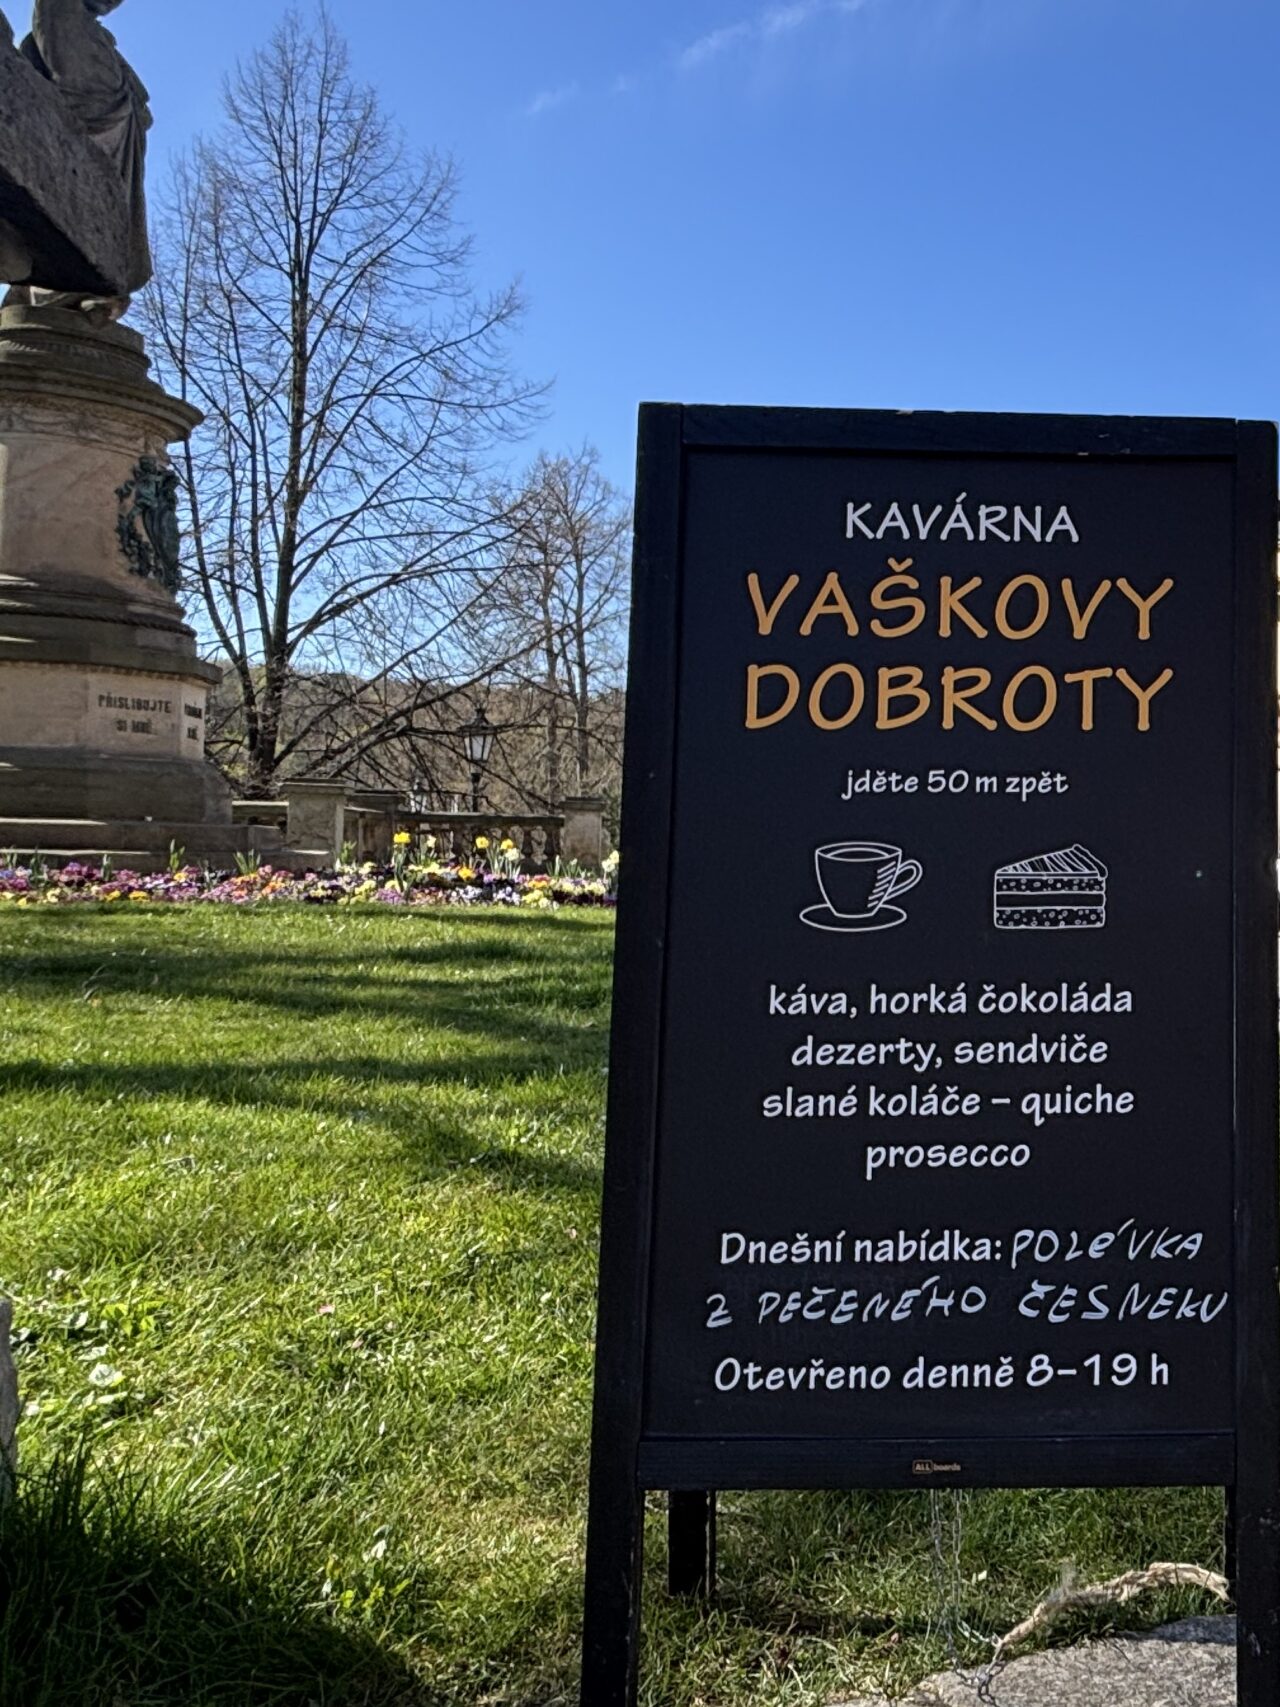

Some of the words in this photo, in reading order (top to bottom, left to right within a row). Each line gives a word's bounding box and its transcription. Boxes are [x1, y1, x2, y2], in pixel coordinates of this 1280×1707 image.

[846, 491, 1080, 543] KAVÁRNA
[747, 557, 1174, 641] VAŠKOVY
[745, 663, 1174, 732] DOBROTY
[841, 768, 919, 801] jděte
[927, 769, 970, 793] 50
[975, 776, 998, 793] m
[1005, 771, 1069, 803] zpět
[769, 983, 858, 1019] káva,
[869, 981, 967, 1015] horká
[977, 981, 1132, 1014] čokoláda
[791, 1034, 943, 1073] dezerty,
[954, 1032, 1108, 1064] sendviče
[762, 1084, 858, 1118] slané
[868, 1083, 981, 1117] koláče
[1020, 1083, 1135, 1127] quiche
[865, 1144, 1031, 1181] prosecco
[720, 1229, 846, 1265] Dnešní
[854, 1228, 1002, 1263] nabídka:
[758, 1275, 987, 1324] PEČENÉHO
[1018, 1279, 1228, 1324] ČESNEKU
[714, 1357, 891, 1391] Otevřeno
[902, 1355, 1015, 1389] denně
[1150, 1352, 1169, 1386] h
